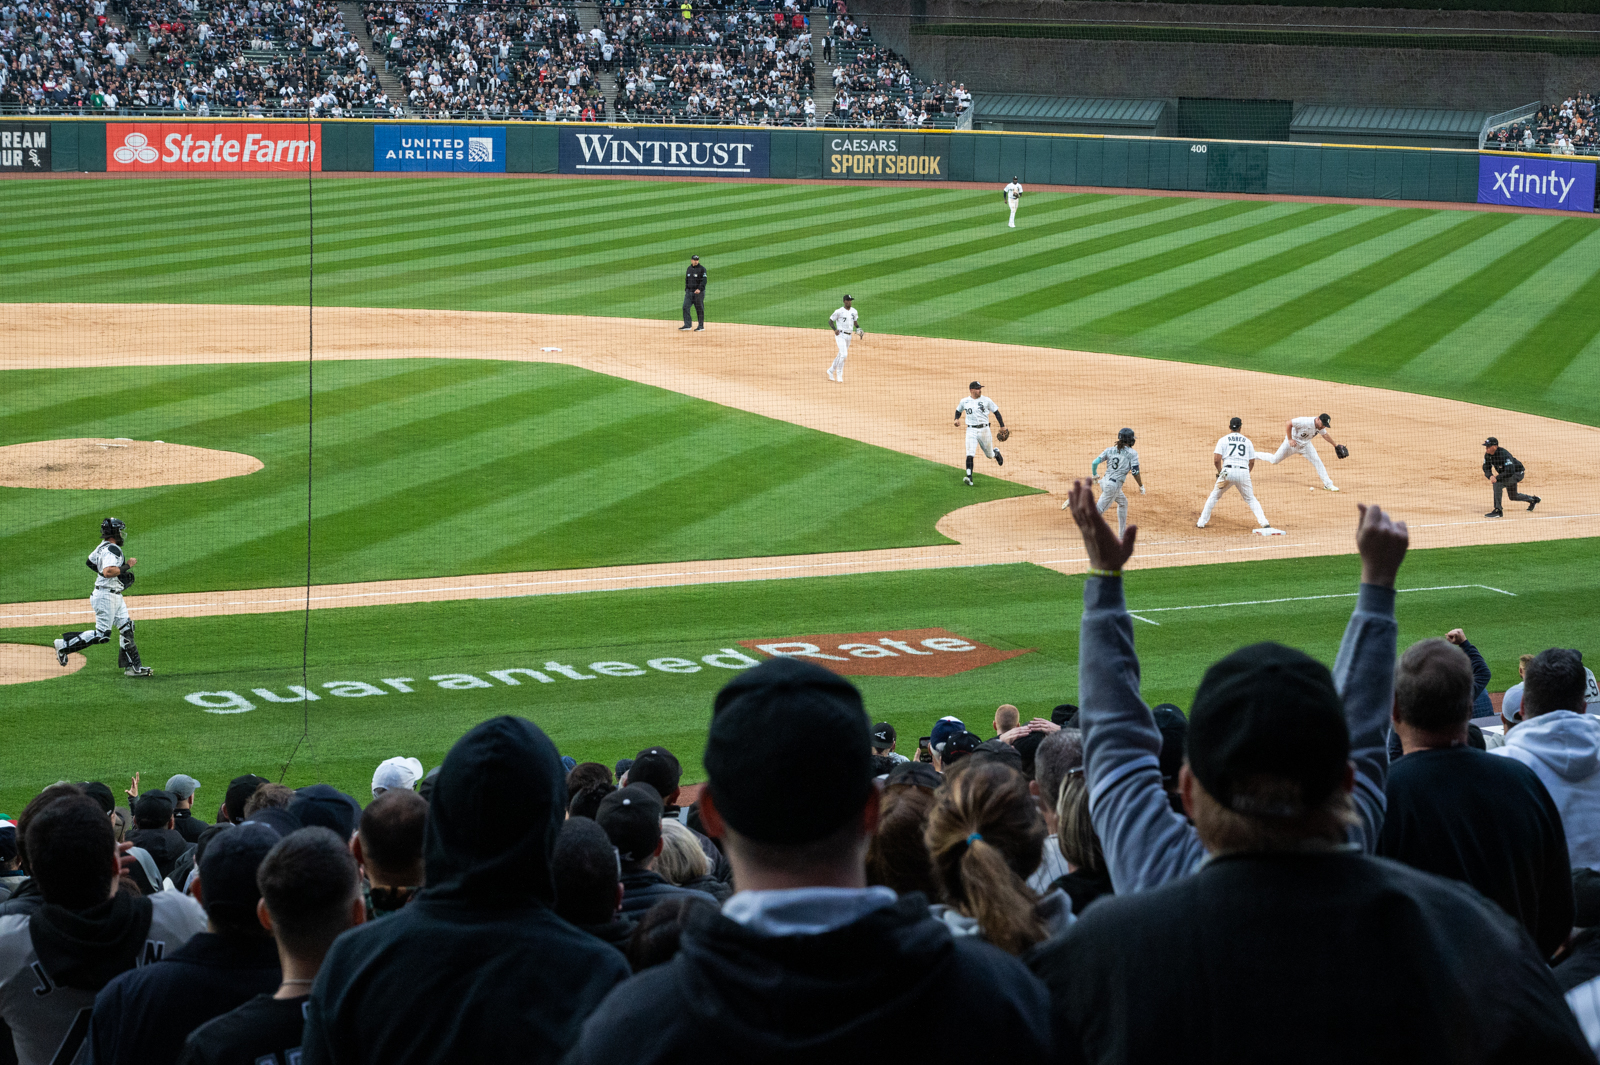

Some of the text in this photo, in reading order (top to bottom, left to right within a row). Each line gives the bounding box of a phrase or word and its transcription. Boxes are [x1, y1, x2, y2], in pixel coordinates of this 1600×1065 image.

[402, 138, 464, 149] UNITED
[576, 133, 752, 166] WINTRUST
[1190, 144, 1207, 153] 400
[385, 149, 464, 160] AIRLINES
[830, 154, 941, 175] SPORTSBOOK
[1492, 164, 1576, 204] xfinity
[1228, 443, 1246, 457] 79
[1111, 457, 1120, 470] 3
[184, 636, 977, 714] guaranteed Rate
